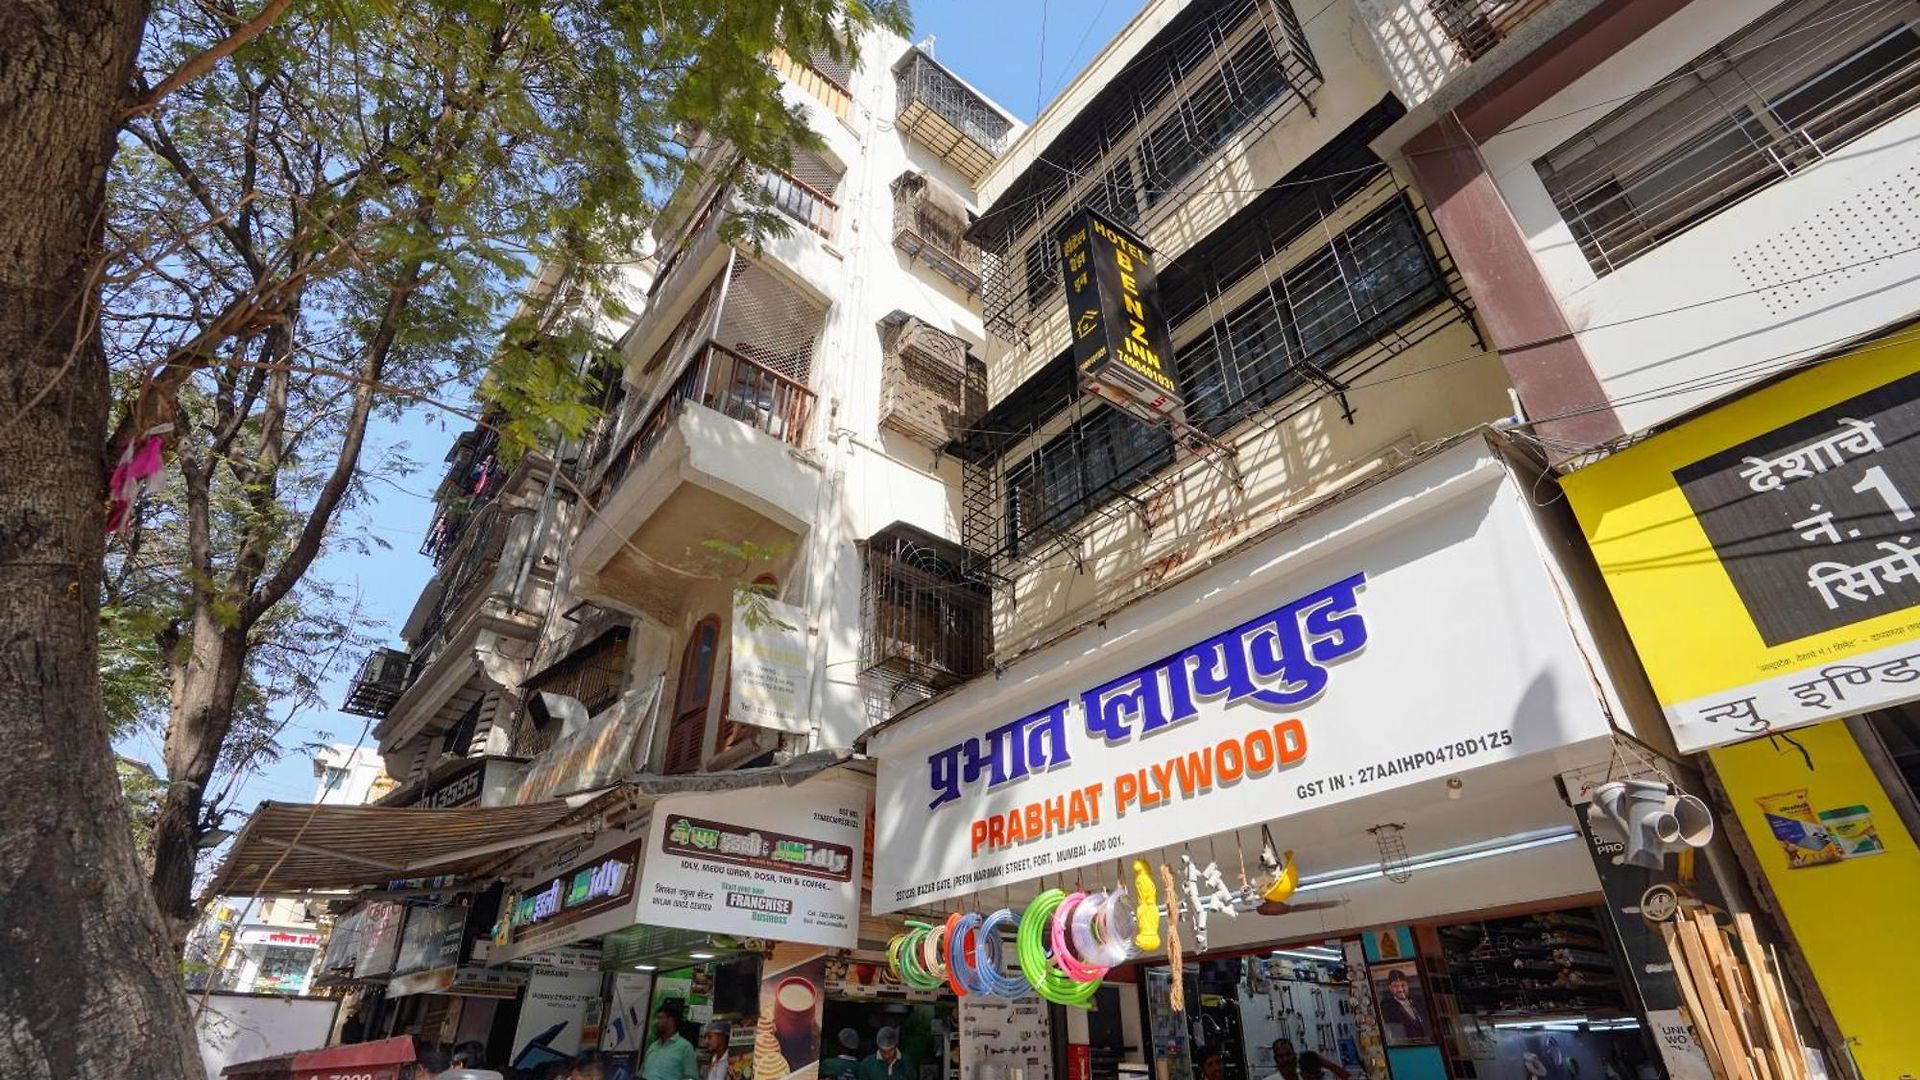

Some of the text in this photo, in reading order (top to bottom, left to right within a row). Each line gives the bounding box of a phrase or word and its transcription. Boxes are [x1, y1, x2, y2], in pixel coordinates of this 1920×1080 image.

[1093, 220, 1148, 265] HOTEL
[1116, 248, 1150, 346] BENZ
[1124, 337, 1160, 369] INN
[1739, 417, 1884, 492] देशाचे
[1792, 465, 1916, 544] नं. 1
[927, 570, 1368, 810] प्रभात प्लायवुड
[970, 718, 1308, 855] PRABHAT PLYWOOD
[1296, 780, 1324, 800] GST
[1329, 774, 1346, 792] IN
[1357, 729, 1513, 784] 27AAIHP0478D1Z5
[701, 863, 725, 875] MEDU
[778, 874, 793, 885] TEA
[916, 882, 936, 896] BAZAR
[1004, 859, 1032, 876] STREET,
[1032, 853, 1053, 868] FORT,
[1055, 844, 1086, 863] MUMBAI
[1092, 840, 1107, 855] 400
[1107, 835, 1125, 850] 001.
[728, 893, 790, 914] FRANCHISE
